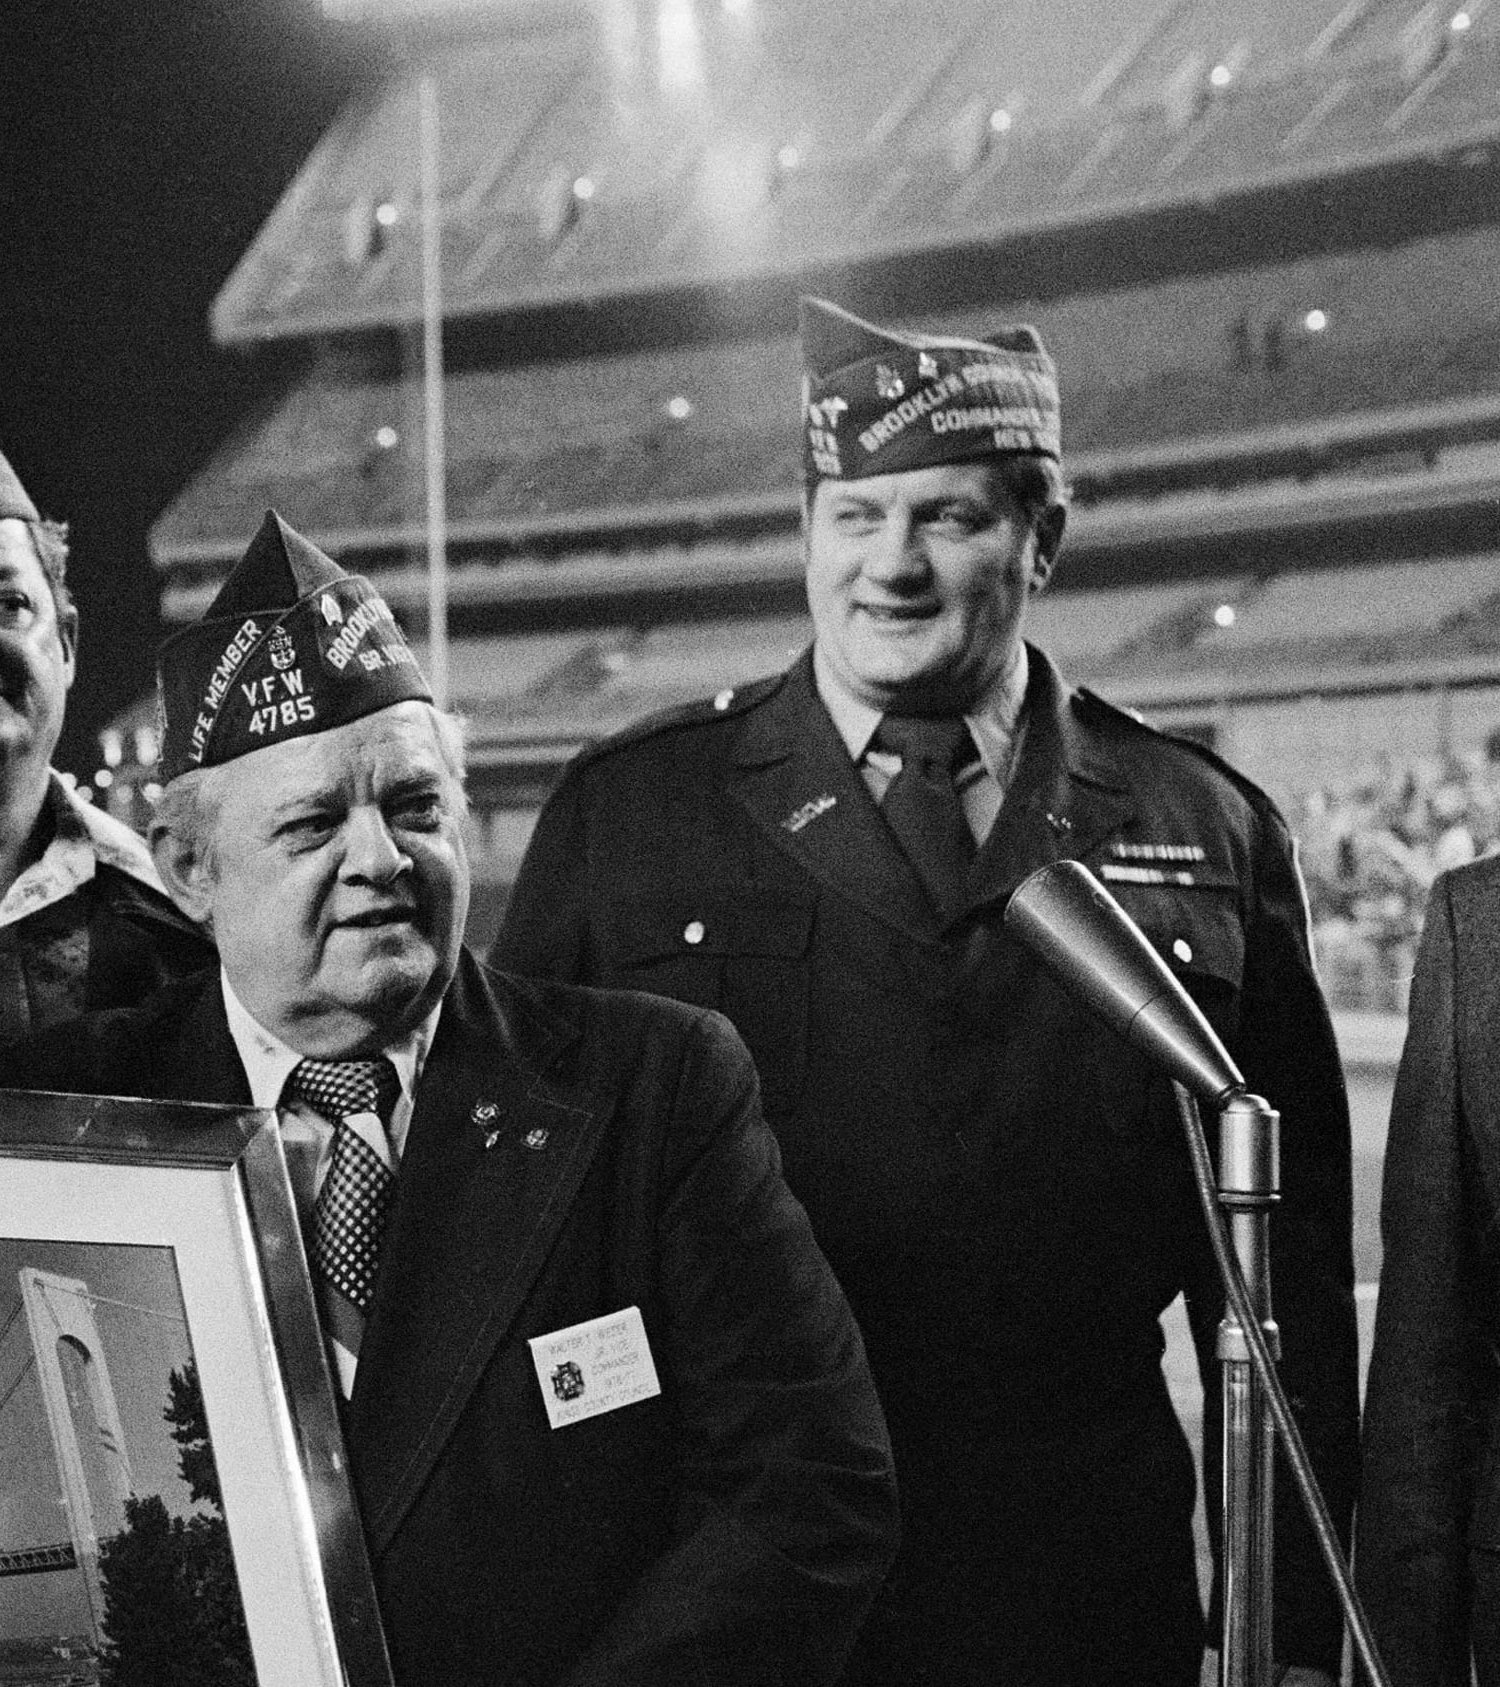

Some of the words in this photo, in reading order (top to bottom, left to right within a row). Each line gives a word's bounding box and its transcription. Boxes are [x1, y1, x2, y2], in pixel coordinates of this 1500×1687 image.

[858, 372, 964, 453] BROOKLYN
[188, 711, 213, 763] LIFE
[204, 618, 263, 710] MEMBER
[248, 695, 316, 735] 4785
